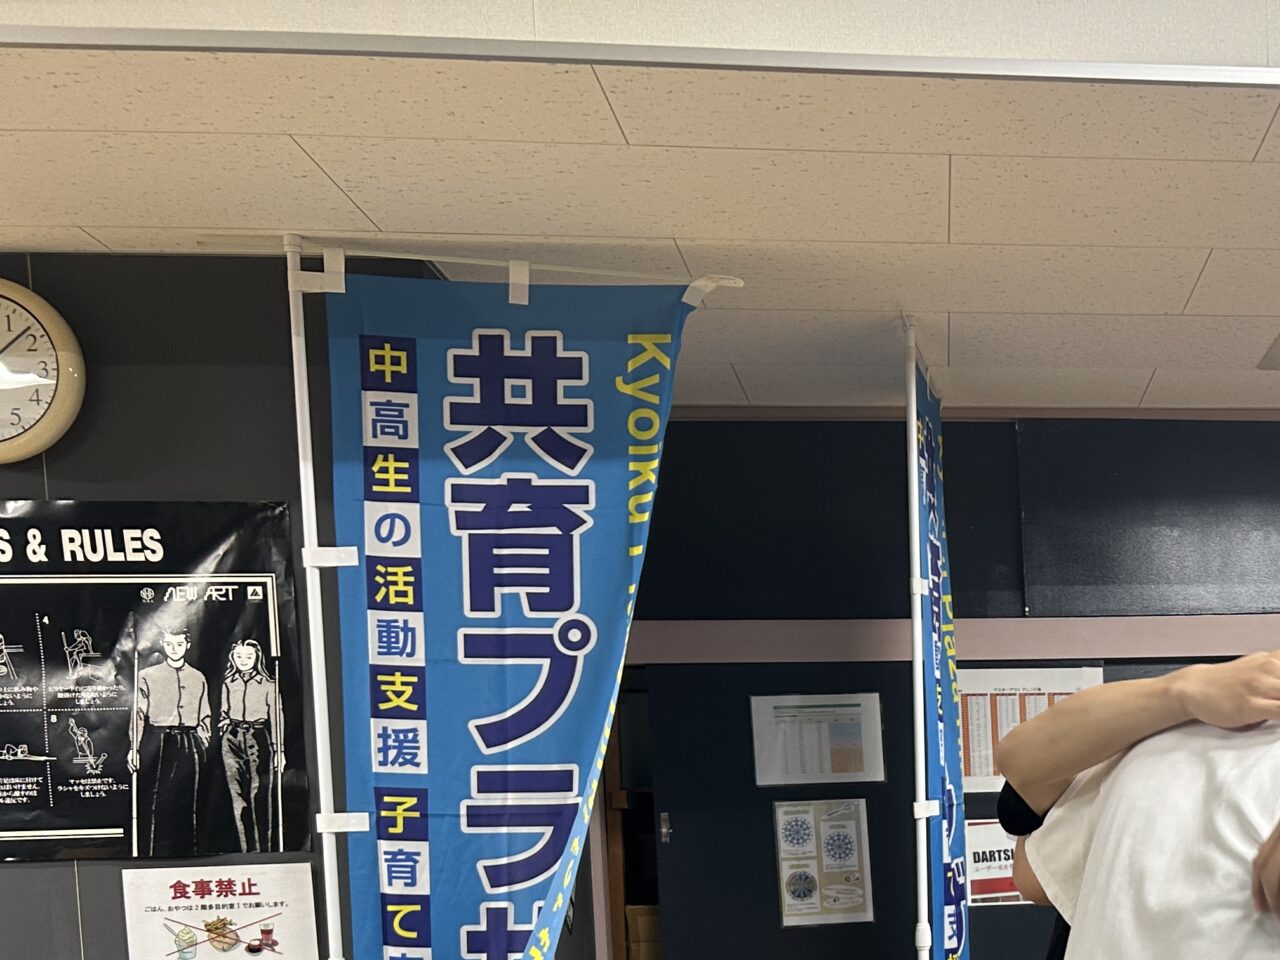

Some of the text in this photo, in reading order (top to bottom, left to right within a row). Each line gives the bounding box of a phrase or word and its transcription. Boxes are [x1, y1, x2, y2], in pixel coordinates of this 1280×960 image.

[26, 334, 38, 352] 2
[37, 356, 49, 376] 3
[29, 388, 43, 406] 4
[10, 408, 22, 425] 5
[615, 333, 673, 524] Kyoiku
[26, 528, 48, 562] &
[60, 528, 164, 562] RULES
[368, 341, 422, 769] 中高生の活動支援
[164, 585, 239, 601] NEW ART
[50, 714, 58, 723] 8
[169, 877, 261, 900] 食事禁止
